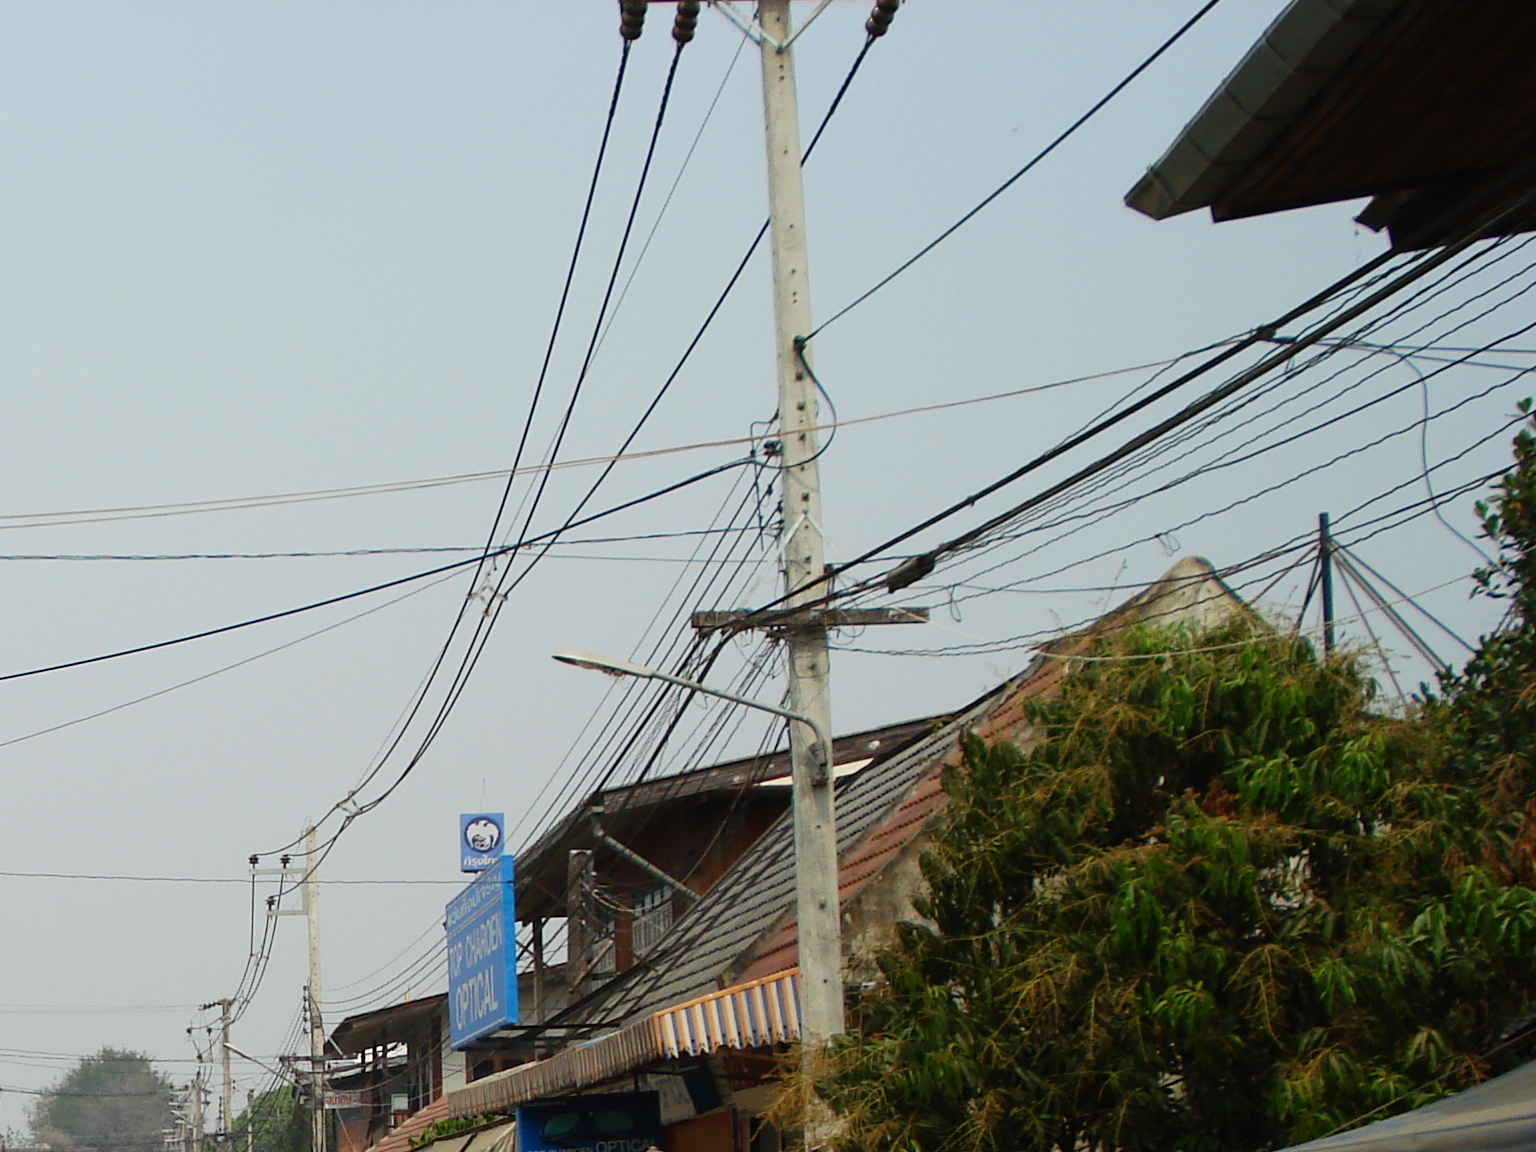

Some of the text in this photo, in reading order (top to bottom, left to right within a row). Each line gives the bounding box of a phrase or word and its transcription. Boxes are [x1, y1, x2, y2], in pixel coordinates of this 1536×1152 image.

[463, 854, 500, 868] กรุงไท
[449, 909, 503, 980] TOP CHAROEN
[455, 965, 499, 1032] OPTICAL
